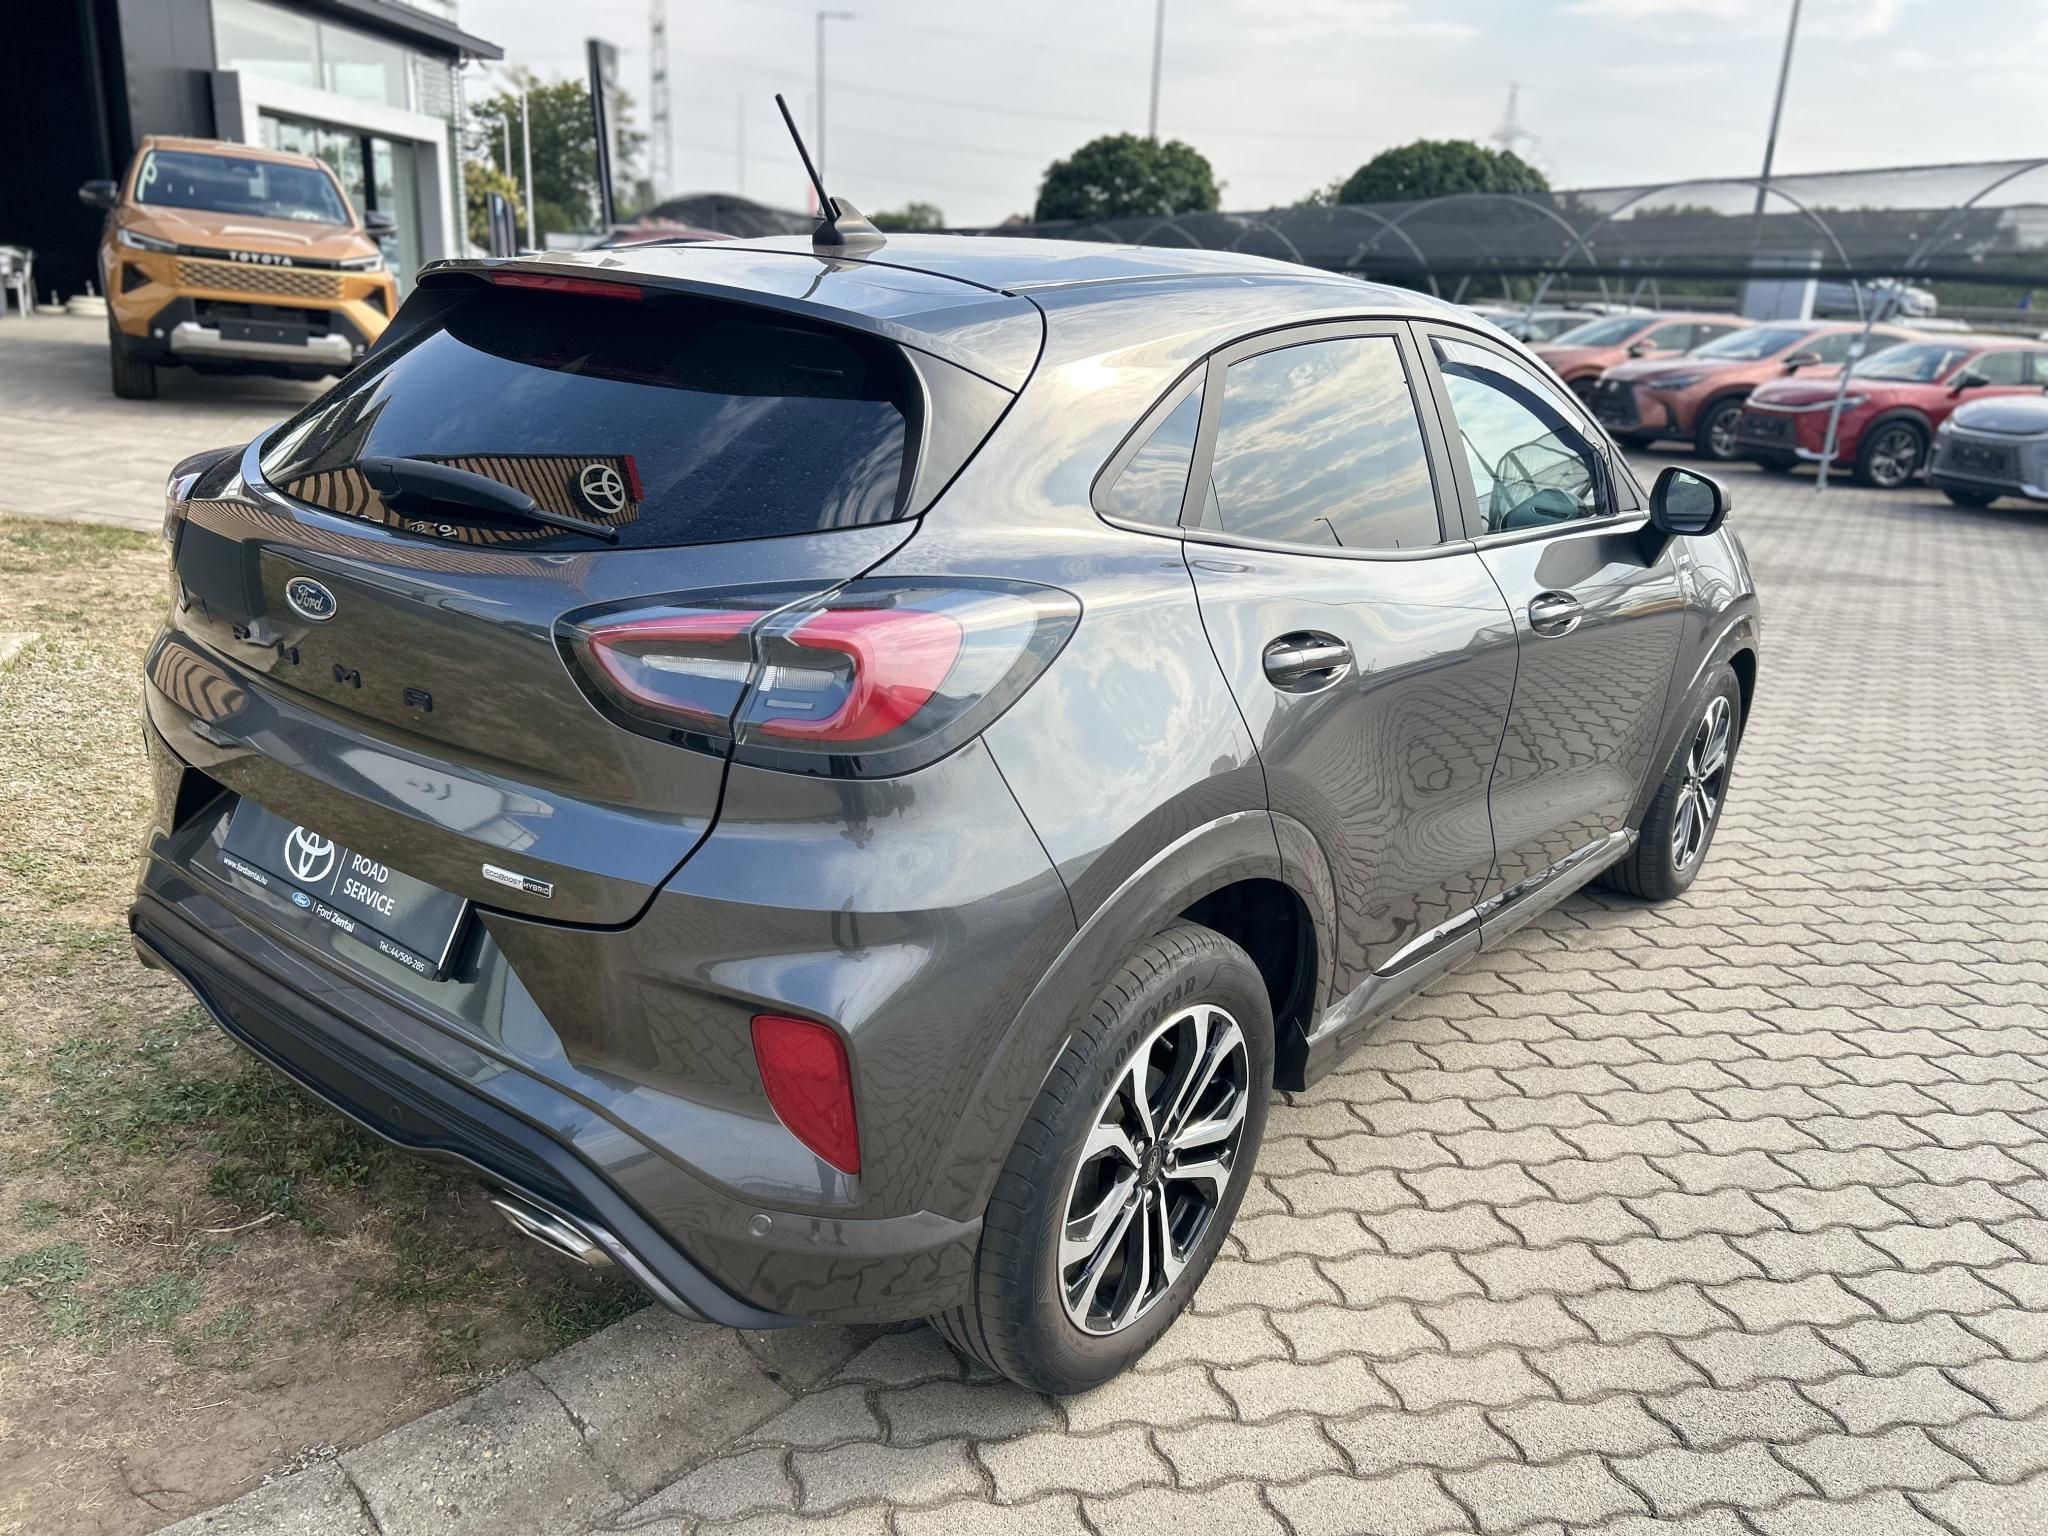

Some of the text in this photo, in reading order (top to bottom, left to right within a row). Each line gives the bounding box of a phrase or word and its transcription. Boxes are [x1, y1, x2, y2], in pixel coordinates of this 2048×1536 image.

[229, 250, 293, 267] TOYOTA
[294, 583, 325, 612] Ford
[351, 853, 389, 883] ROAD
[343, 877, 395, 916] SERVICE
[523, 881, 549, 895] HYBRID
[316, 903, 332, 920] Ford
[1090, 975, 1196, 1108] GOODYEAR
